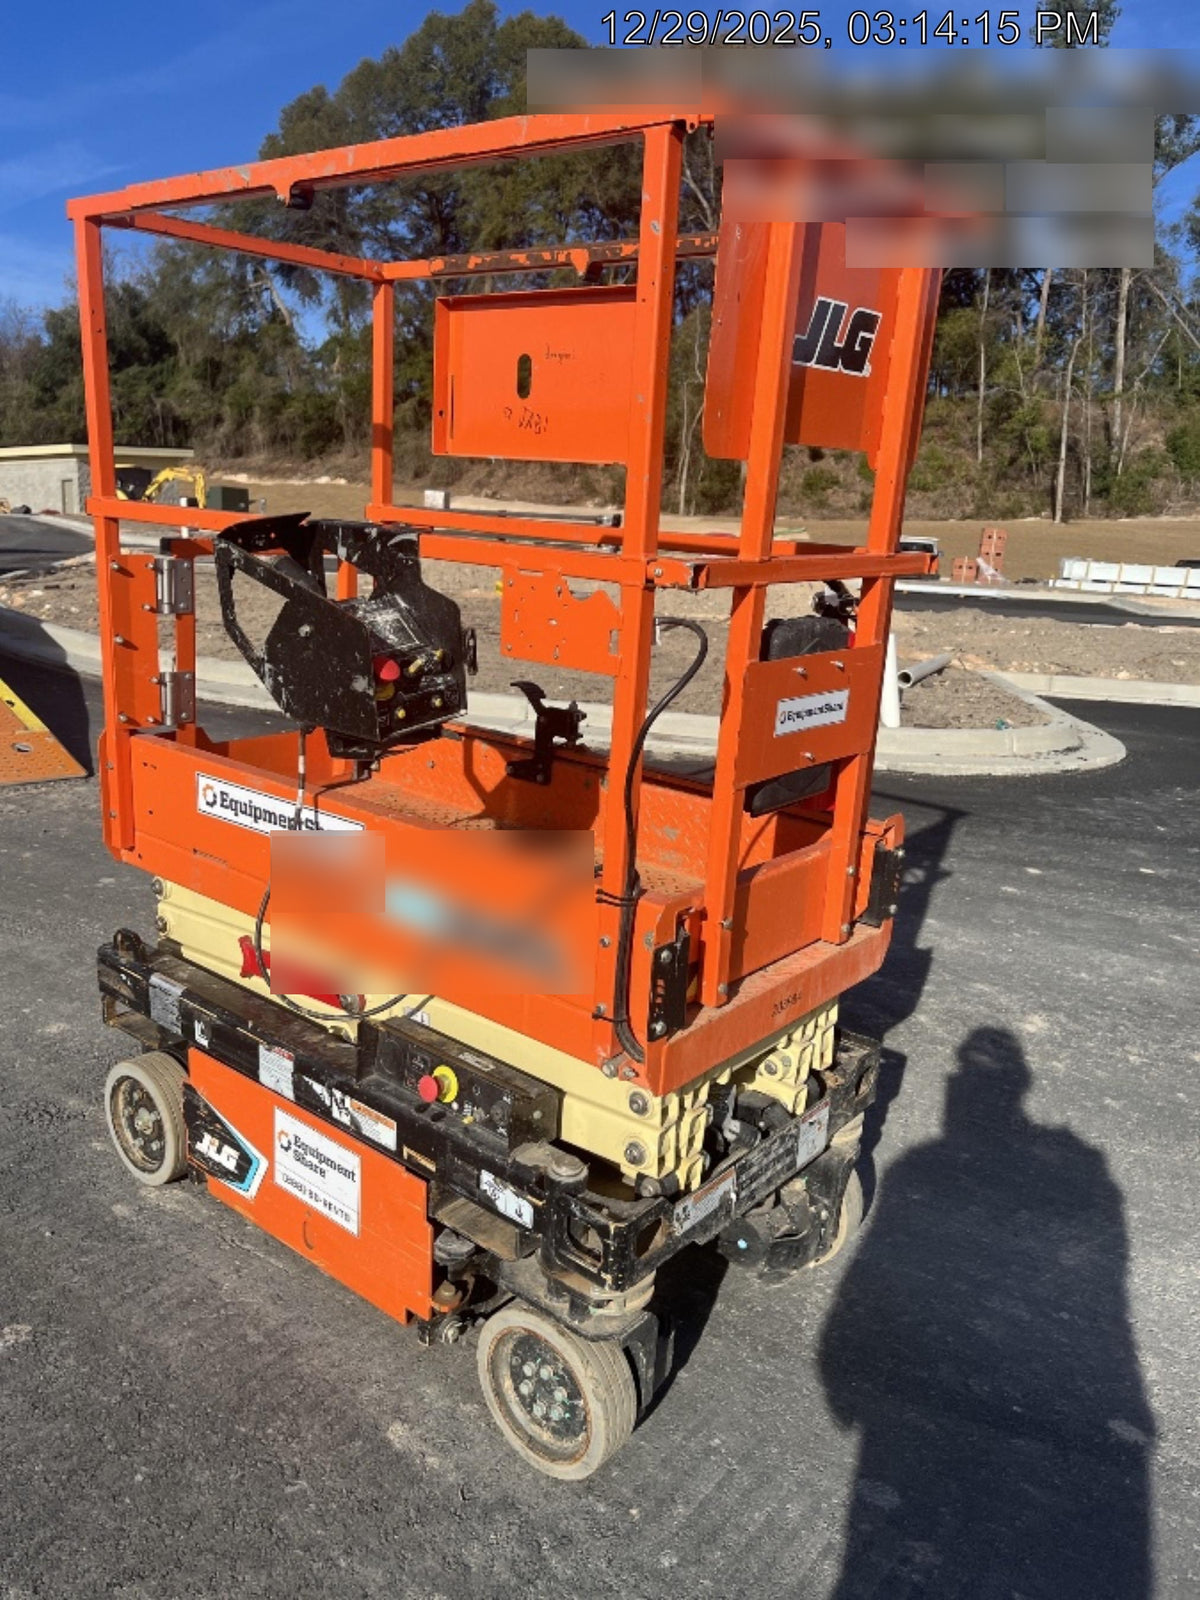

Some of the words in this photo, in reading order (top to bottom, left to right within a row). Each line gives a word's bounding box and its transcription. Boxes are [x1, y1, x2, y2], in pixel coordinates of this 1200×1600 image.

[793, 296, 882, 377] JLG
[195, 1132, 240, 1174] JLG
[293, 1134, 356, 1183] Equipment
[293, 1149, 326, 1178] Share
